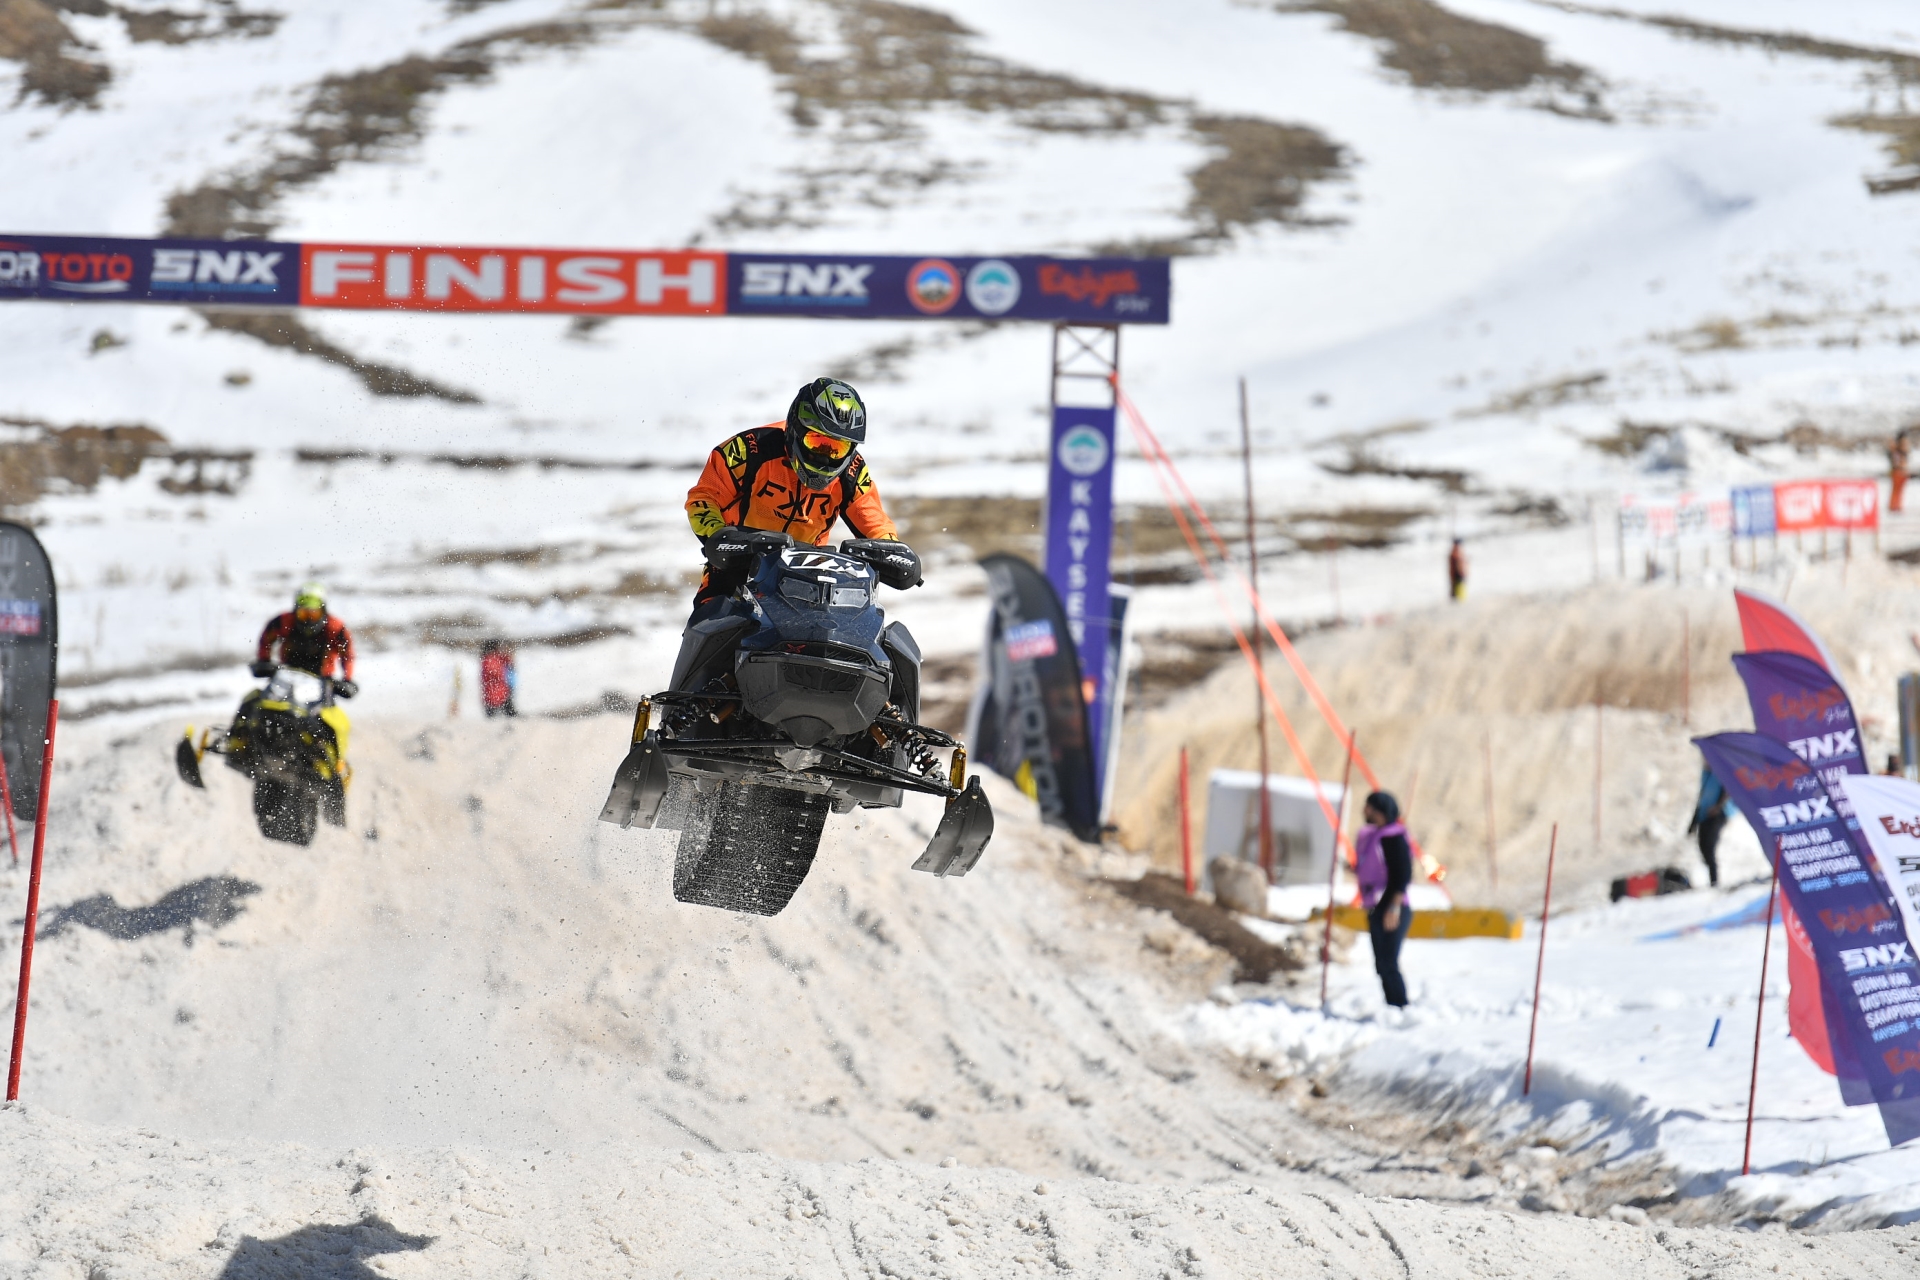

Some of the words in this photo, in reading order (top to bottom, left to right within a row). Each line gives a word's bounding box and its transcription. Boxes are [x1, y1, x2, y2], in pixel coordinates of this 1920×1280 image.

[151, 248, 283, 284] SNX
[311, 251, 716, 305] FINISH
[741, 262, 872, 297] SNX
[745, 433, 758, 453] FXR
[848, 454, 863, 477] FXR
[757, 480, 831, 517] FXR
[1787, 728, 1858, 761] SNX
[1758, 796, 1834, 828] SNX
[1839, 942, 1913, 971] SNX
